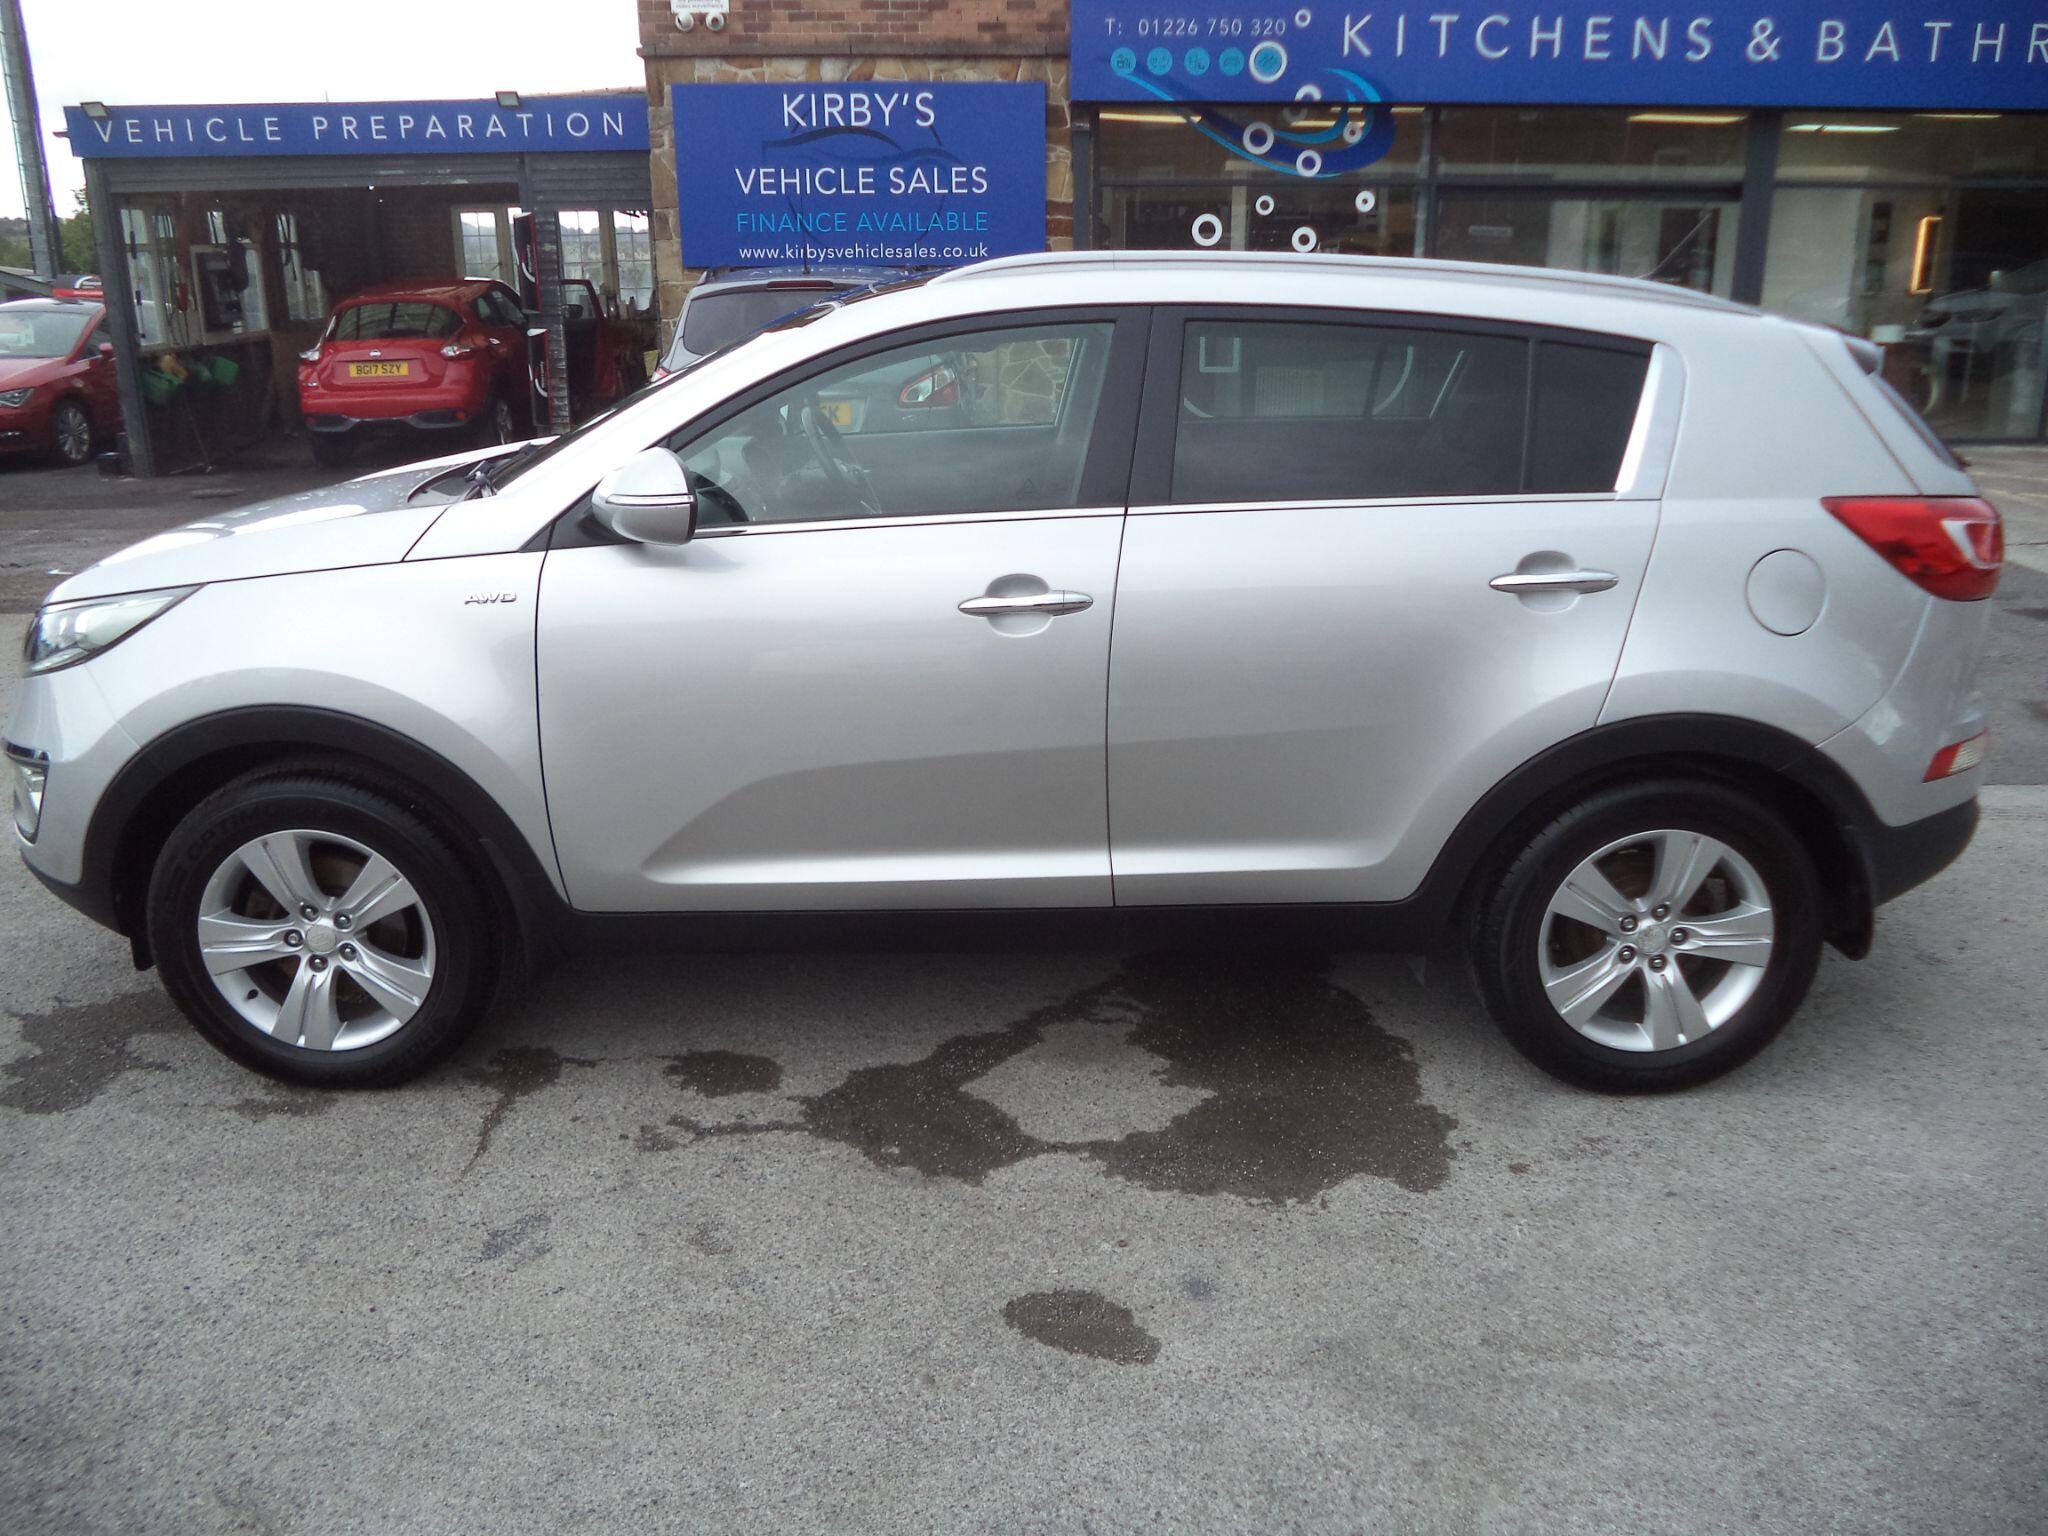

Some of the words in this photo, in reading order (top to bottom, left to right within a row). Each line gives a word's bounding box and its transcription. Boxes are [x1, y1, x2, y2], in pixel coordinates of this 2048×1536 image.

[1105, 18, 1122, 36] T:
[1138, 18, 1198, 36] 01226
[1207, 18, 1243, 36] 750
[1251, 18, 1287, 36] 320
[1343, 14, 1713, 62] KITCHENS
[1746, 18, 1781, 62] &
[1816, 20, 2048, 64] BATHR
[783, 92, 935, 127] KIRBY'S
[94, 117, 281, 142] VEHICLE
[312, 112, 624, 140] PREPARATION
[735, 168, 876, 195] VEHICLE
[889, 166, 988, 194] SALES
[736, 212, 847, 232] FINANCE
[856, 212, 989, 232] AVAILABLE
[356, 364, 378, 375] BG17
[381, 363, 401, 374] SZY
[464, 592, 517, 605] AWD
